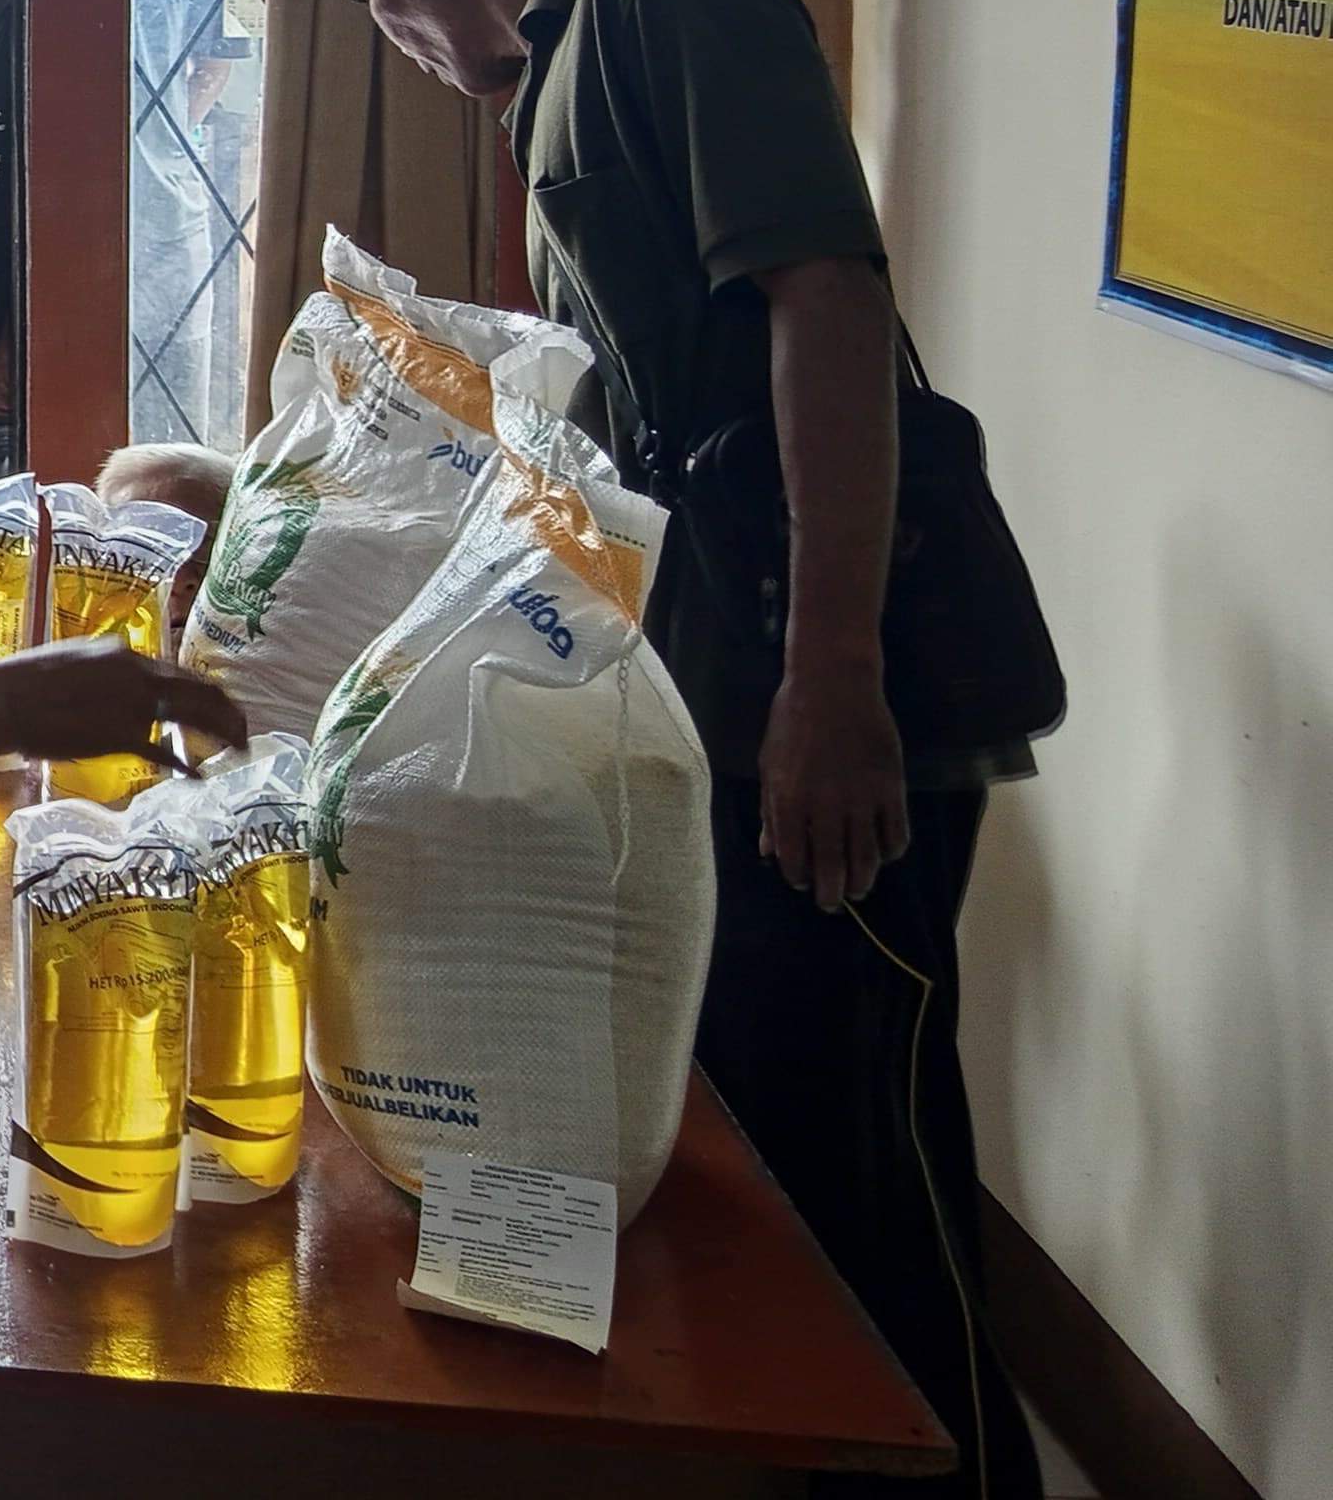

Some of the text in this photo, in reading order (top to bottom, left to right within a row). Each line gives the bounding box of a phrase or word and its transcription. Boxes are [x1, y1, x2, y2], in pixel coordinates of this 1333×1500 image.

[506, 583, 574, 660] ulog
[119, 903, 149, 916] SAWIT
[89, 974, 113, 989] HET
[113, 974, 128, 990] Rp
[341, 1065, 479, 1104] TIDAK UNTUK
